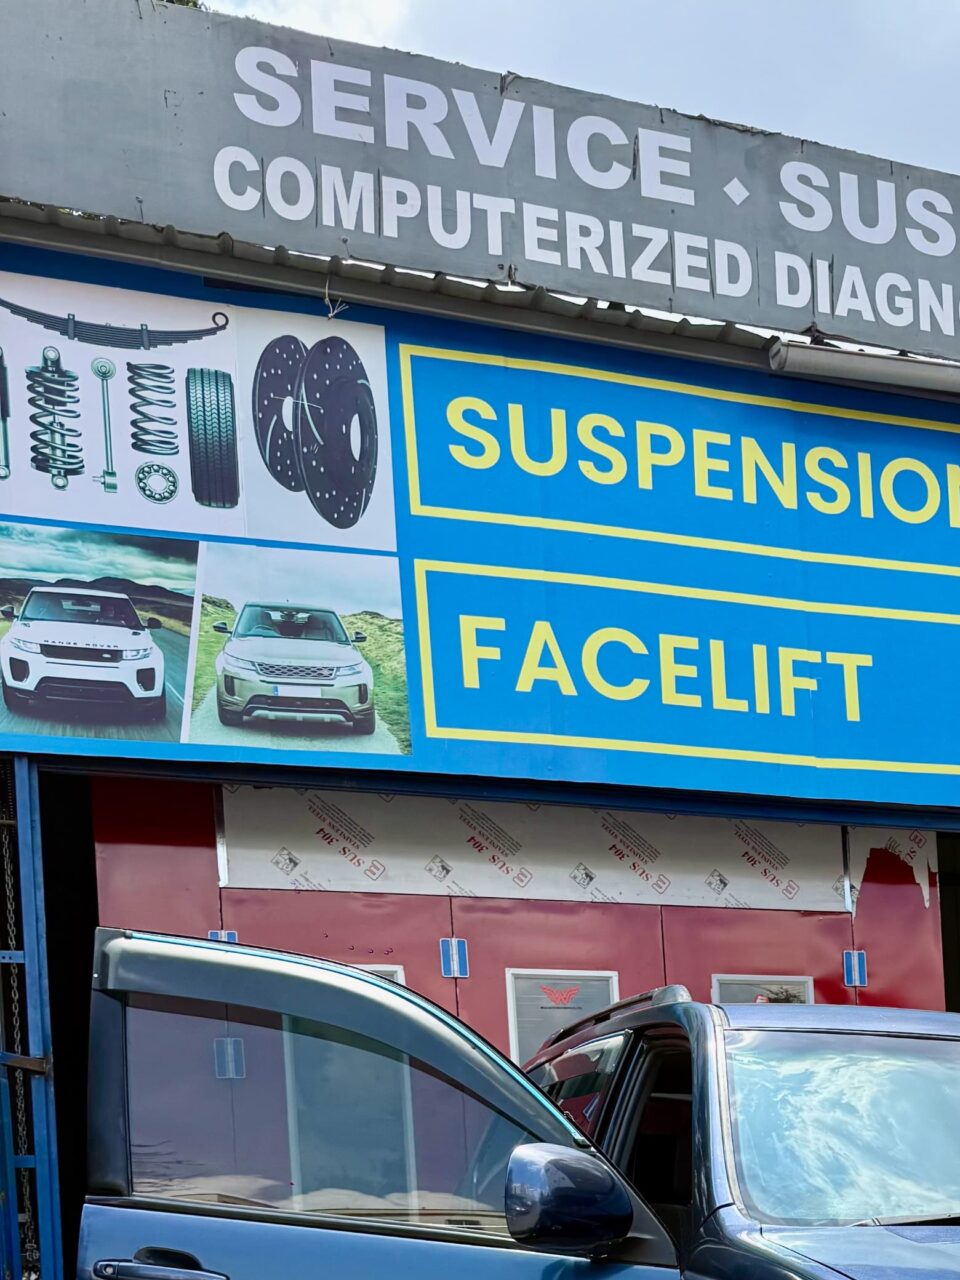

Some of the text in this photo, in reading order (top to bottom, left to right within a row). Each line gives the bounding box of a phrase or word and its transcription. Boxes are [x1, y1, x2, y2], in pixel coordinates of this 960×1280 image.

[234, 46, 695, 205] SERVICE
[214, 146, 753, 298] COMPUTERIZED
[459, 614, 873, 722] FACELIFT
